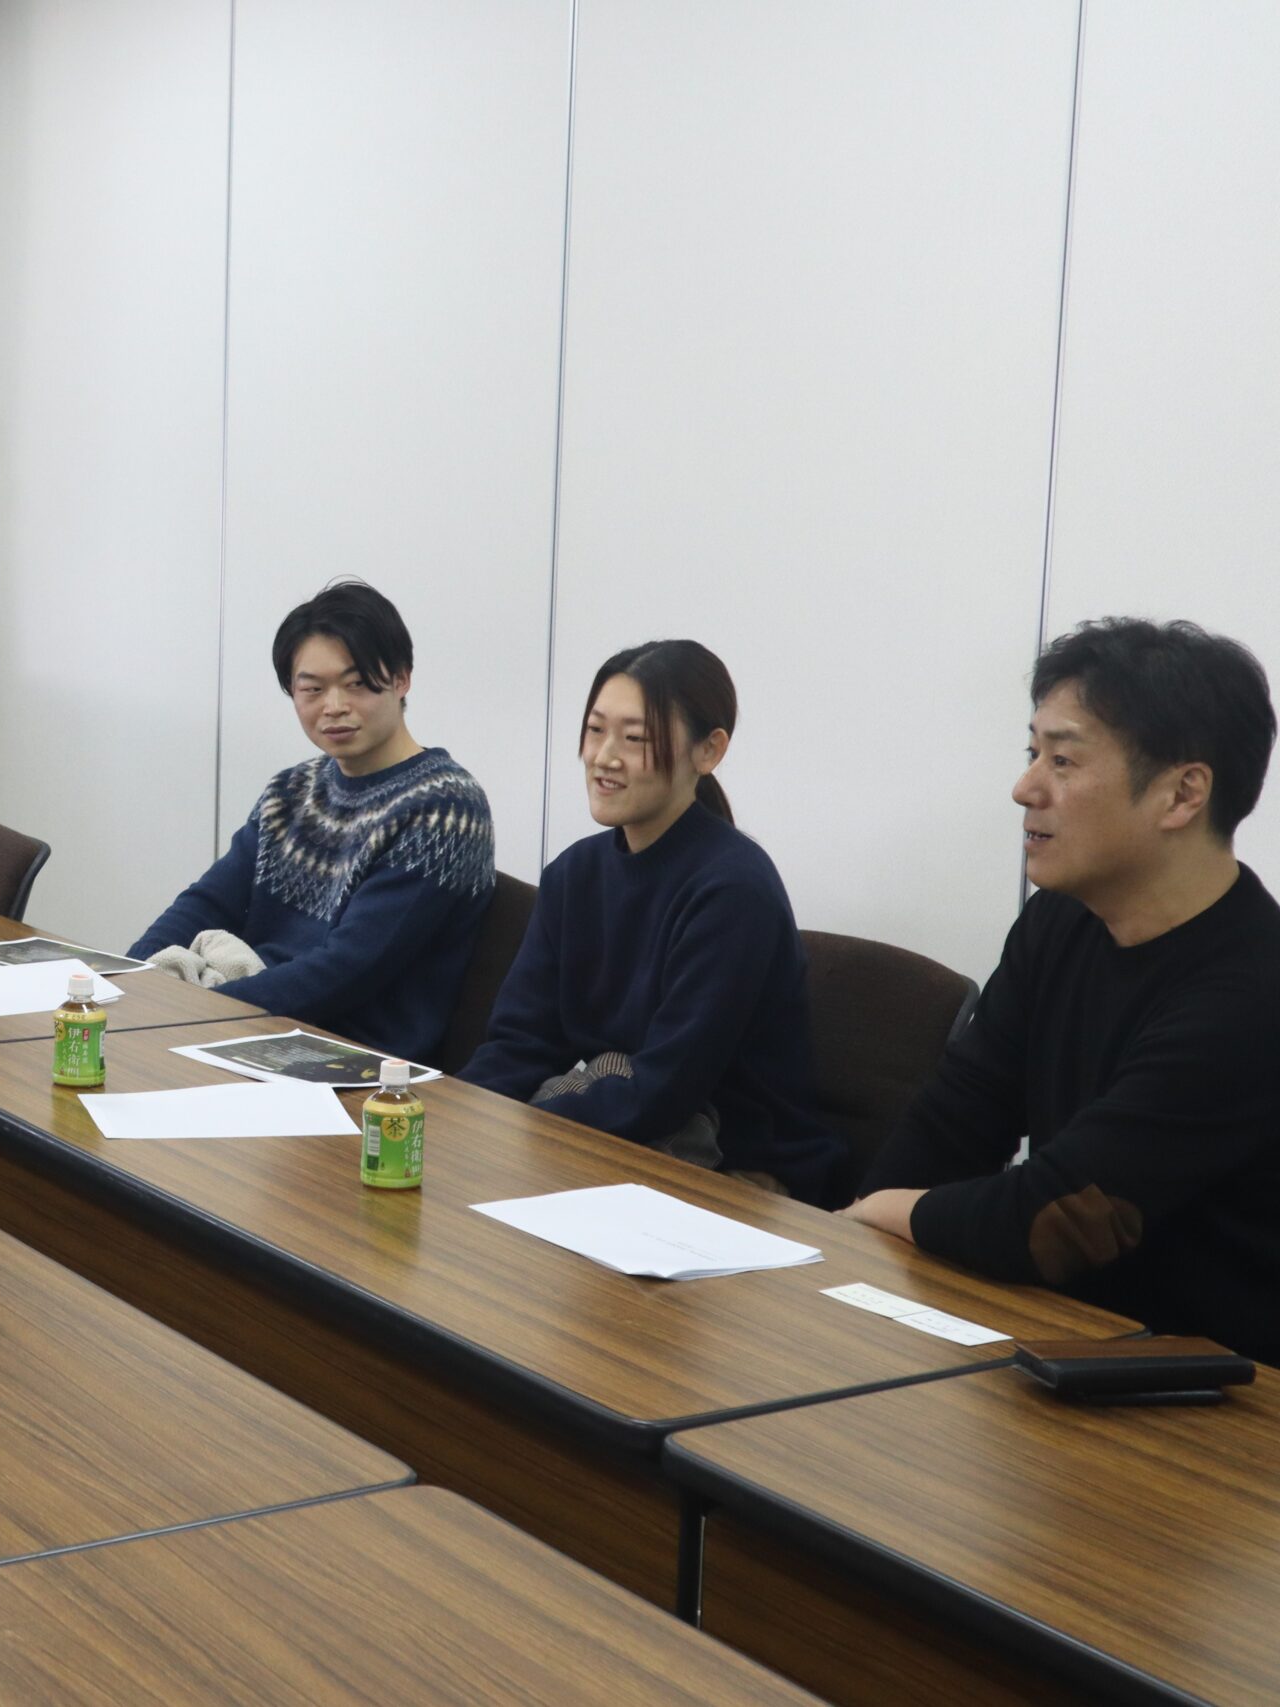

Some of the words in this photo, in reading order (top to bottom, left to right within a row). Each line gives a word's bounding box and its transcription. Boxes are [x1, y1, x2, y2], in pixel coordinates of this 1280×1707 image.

[67, 1027, 81, 1080] 伊右衛門
[384, 1117, 406, 1138] 茶
